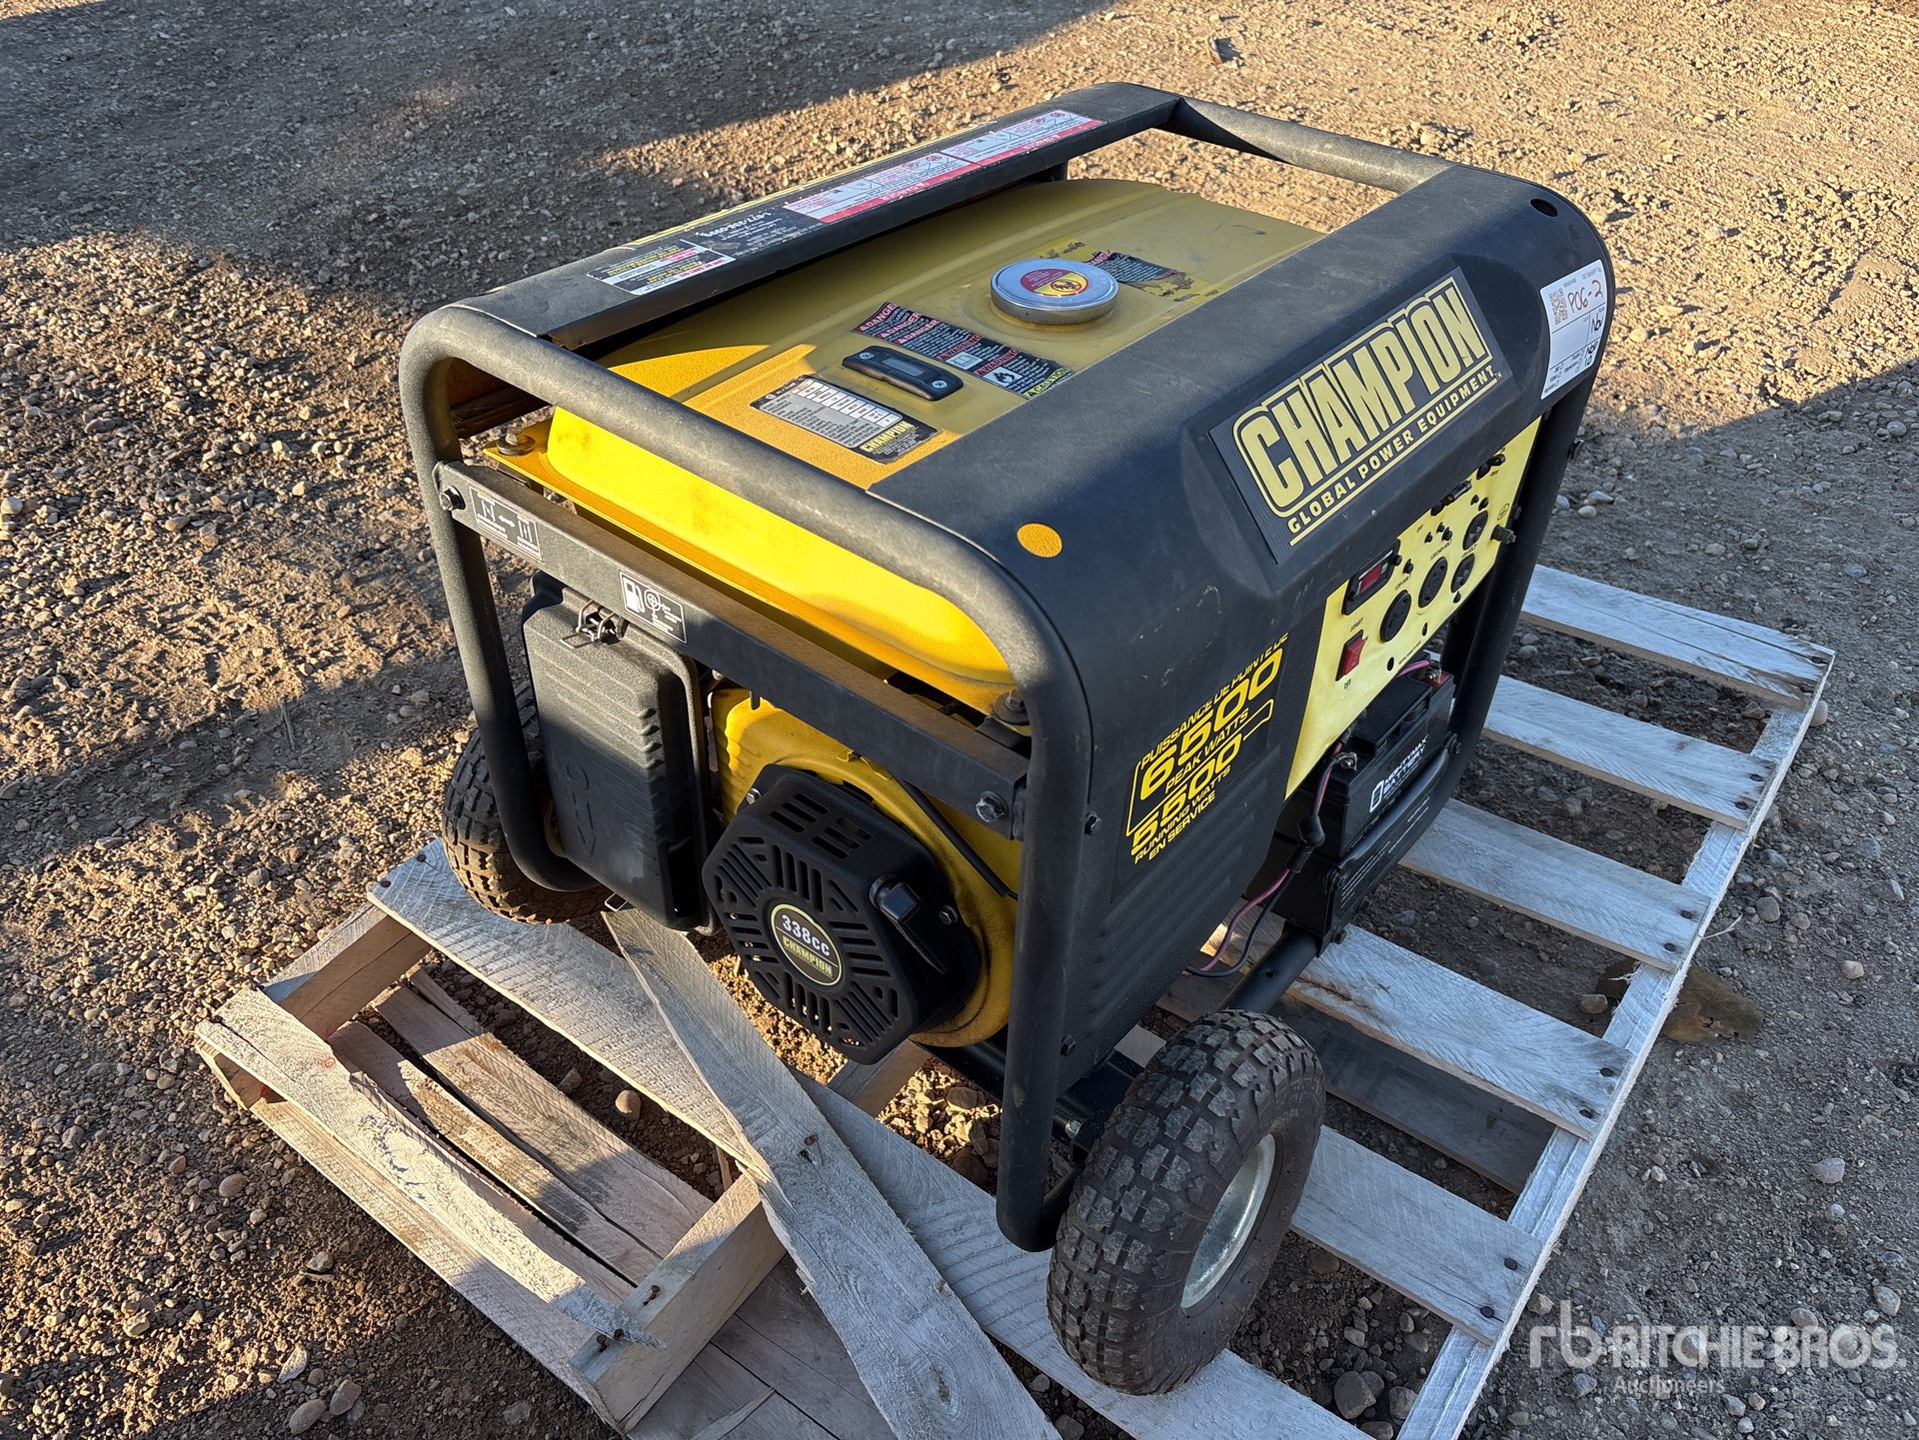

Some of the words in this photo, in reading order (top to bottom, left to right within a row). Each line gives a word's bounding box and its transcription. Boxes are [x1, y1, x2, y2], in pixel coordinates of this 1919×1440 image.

[888, 312, 921, 333] DANGER
[905, 320, 941, 340] DANGER
[1240, 287, 1487, 506] CHAMPION
[860, 421, 916, 453] CHAMPION
[1287, 473, 1357, 534] GLOBAL
[1360, 431, 1415, 479] POWER
[1419, 365, 1496, 434] EQUIPMENT
[1140, 647, 1283, 800] 6500
[1140, 698, 1213, 769] PUISSANCE
[1165, 751, 1203, 794] PEAK
[1204, 707, 1249, 757] WATTS
[1131, 733, 1242, 856] 5500
[1134, 803, 1190, 865] RUNNING
[1191, 765, 1231, 806] WATTS
[1148, 839, 1167, 861] EN
[1167, 790, 1216, 843] SERVICE
[782, 935, 833, 975] CHAMPION
